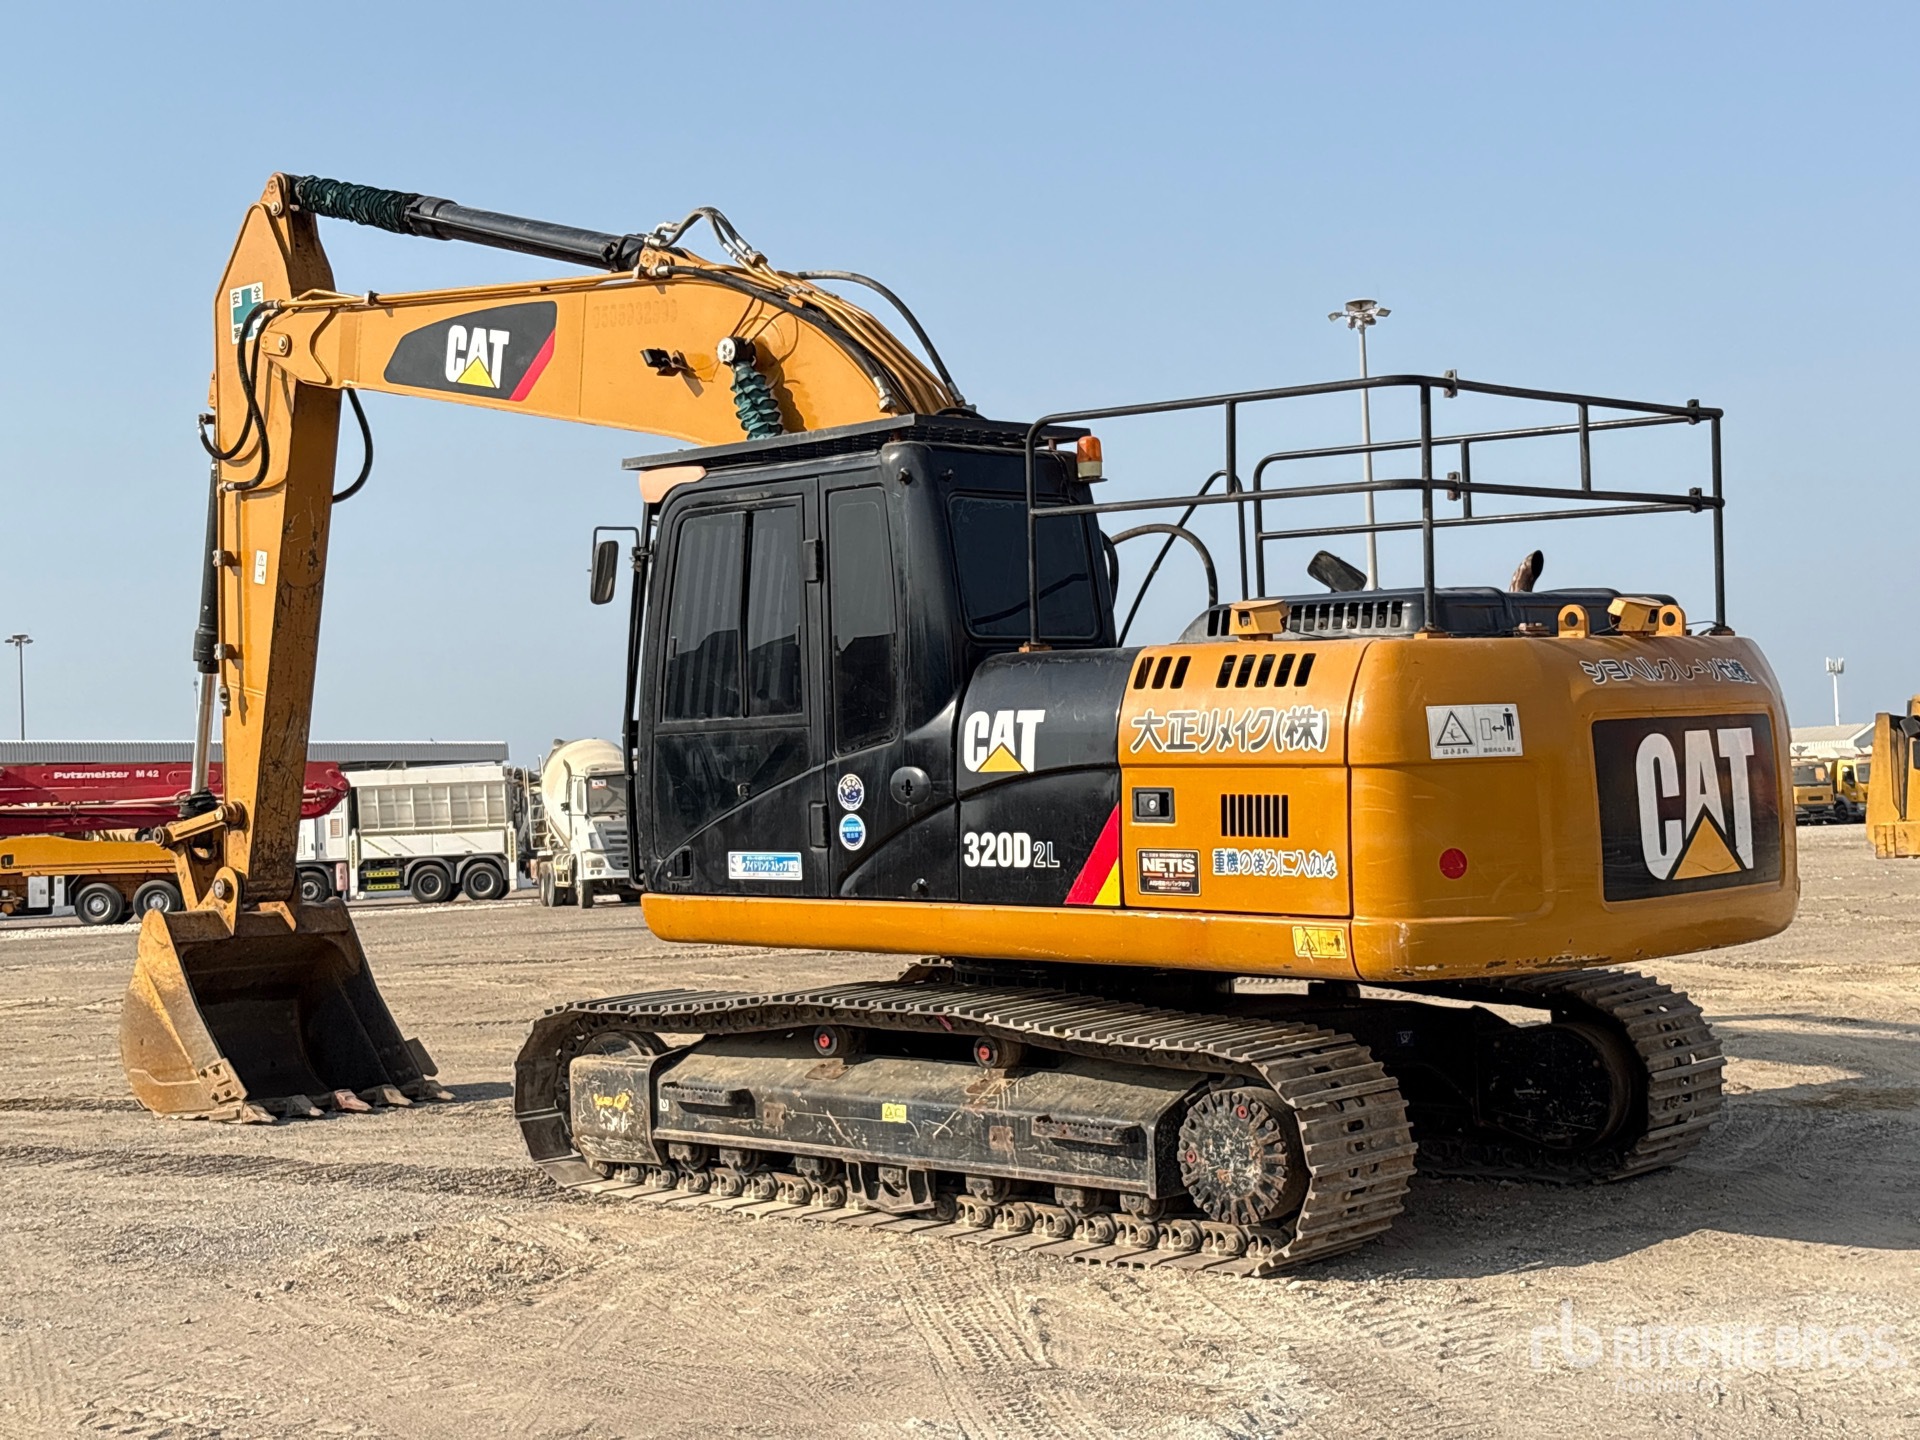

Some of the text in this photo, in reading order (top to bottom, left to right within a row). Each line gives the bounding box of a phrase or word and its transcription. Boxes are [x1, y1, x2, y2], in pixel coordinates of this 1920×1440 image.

[445, 325, 510, 389] CAT
[963, 709, 1046, 773] CAT
[53, 770, 160, 780] Putzmeister M 42
[1635, 727, 1755, 881] CAT
[1142, 857, 1196, 873] NETIS
